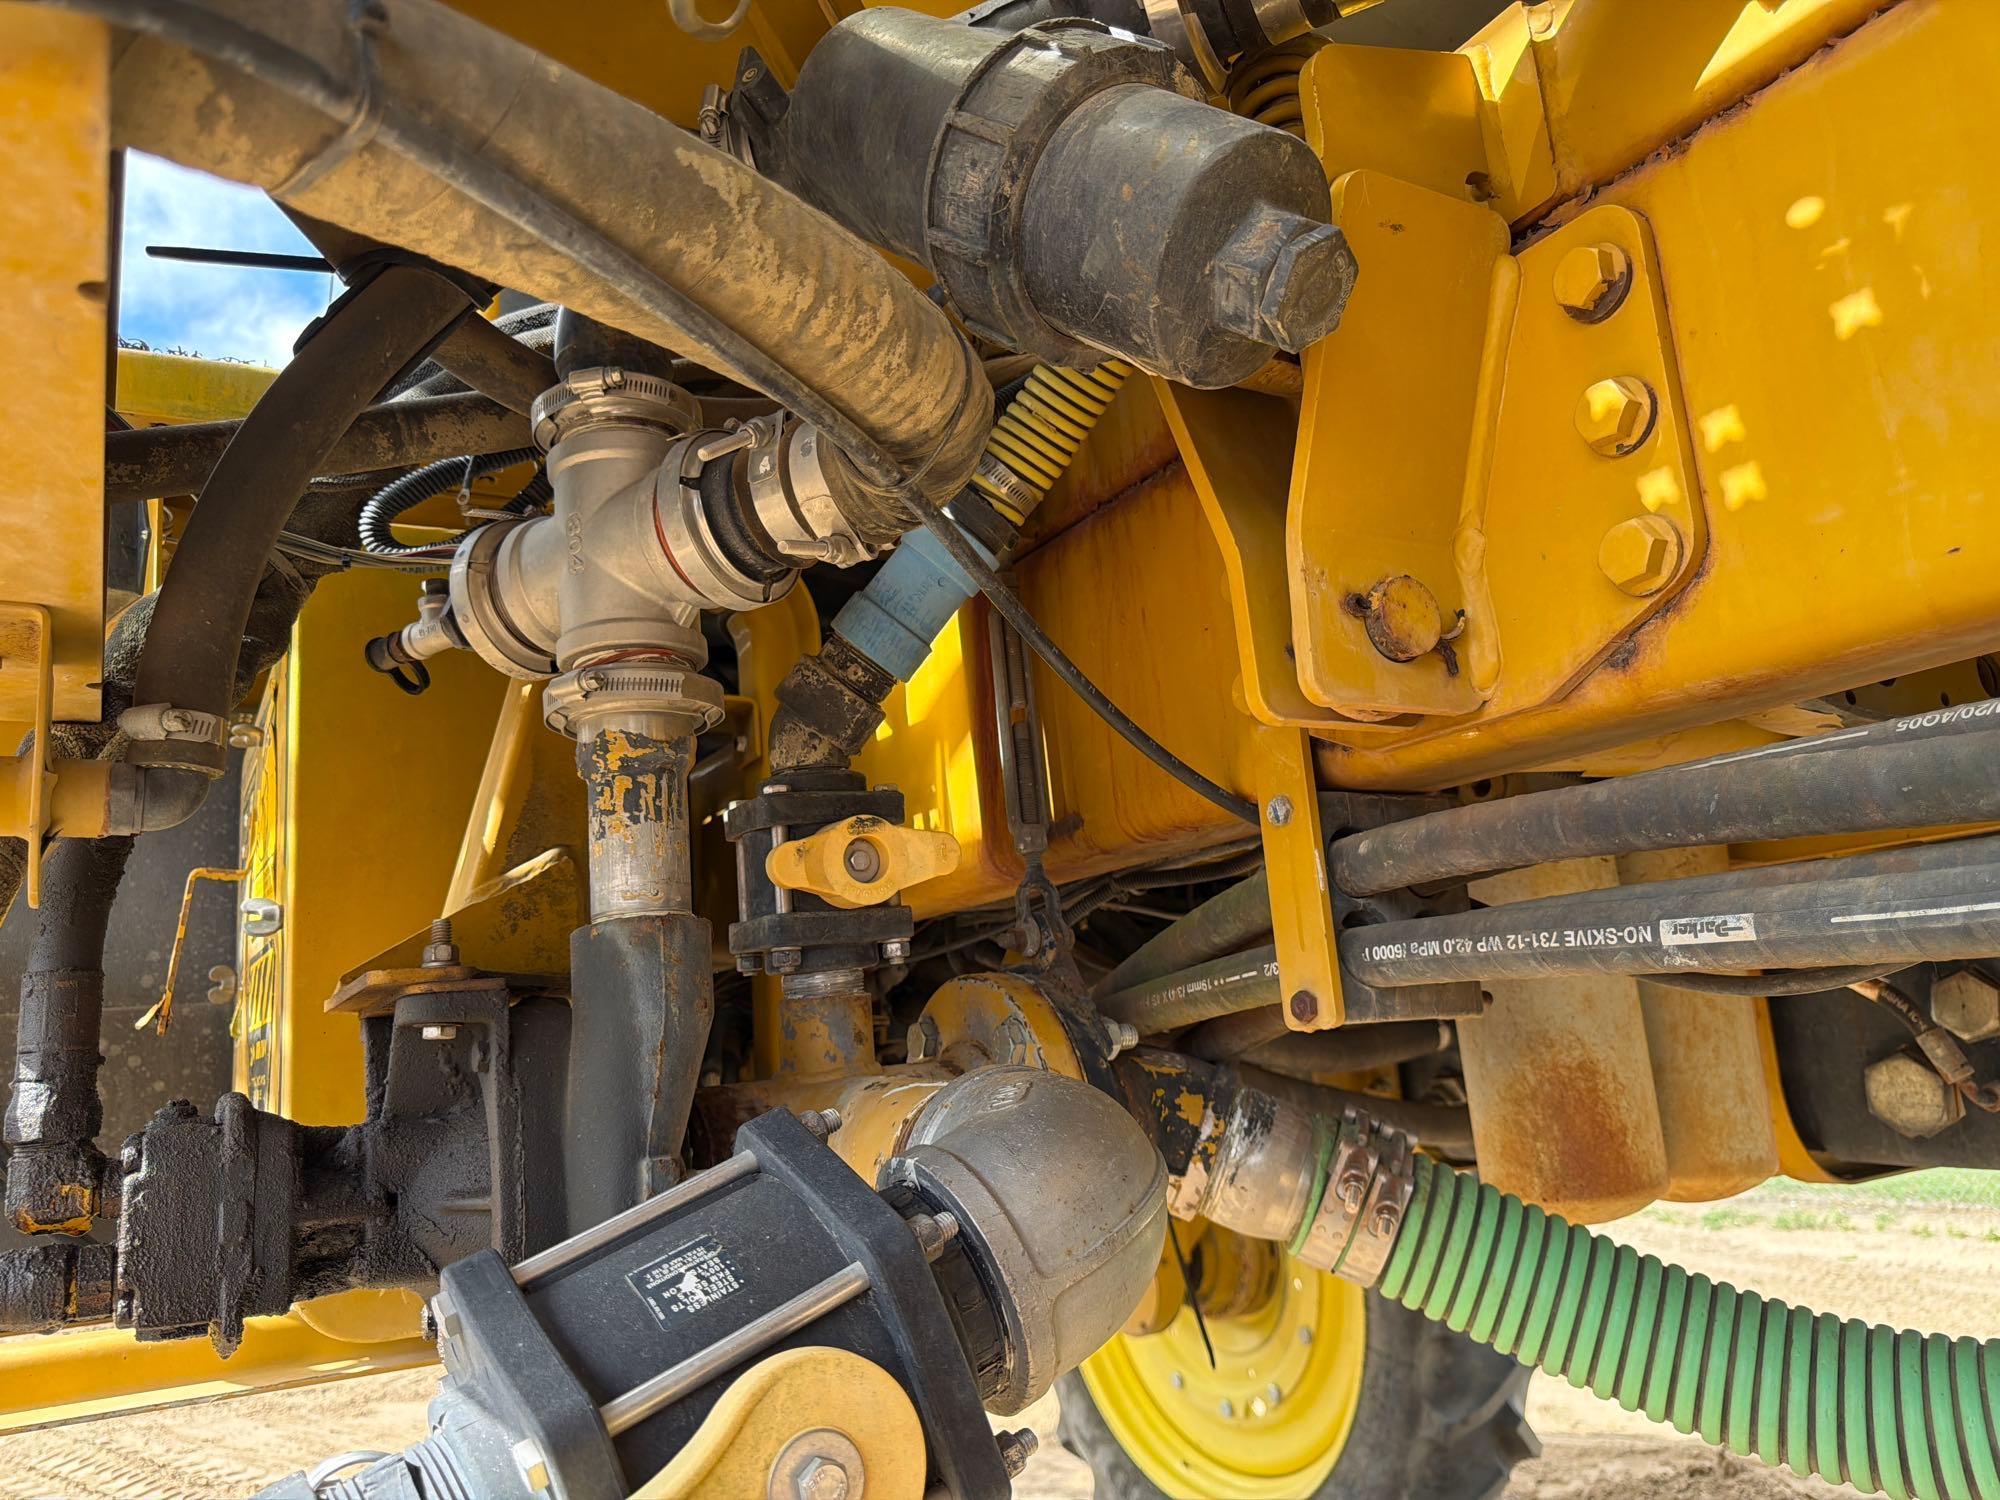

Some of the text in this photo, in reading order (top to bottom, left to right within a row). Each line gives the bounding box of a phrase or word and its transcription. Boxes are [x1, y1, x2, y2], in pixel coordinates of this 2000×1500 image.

[1564, 925, 1653, 947] NO-SKIVE
[1671, 919, 1743, 938] Parker
[1410, 940, 1440, 956] MPa
[1477, 935, 1501, 952] WP
[1507, 931, 1560, 949] 731-12
[700, 1262, 724, 1278] 100%
[676, 1267, 730, 1300] FKM SELS
[703, 1274, 734, 1294] STEEL
[670, 1292, 701, 1313] OLTS
